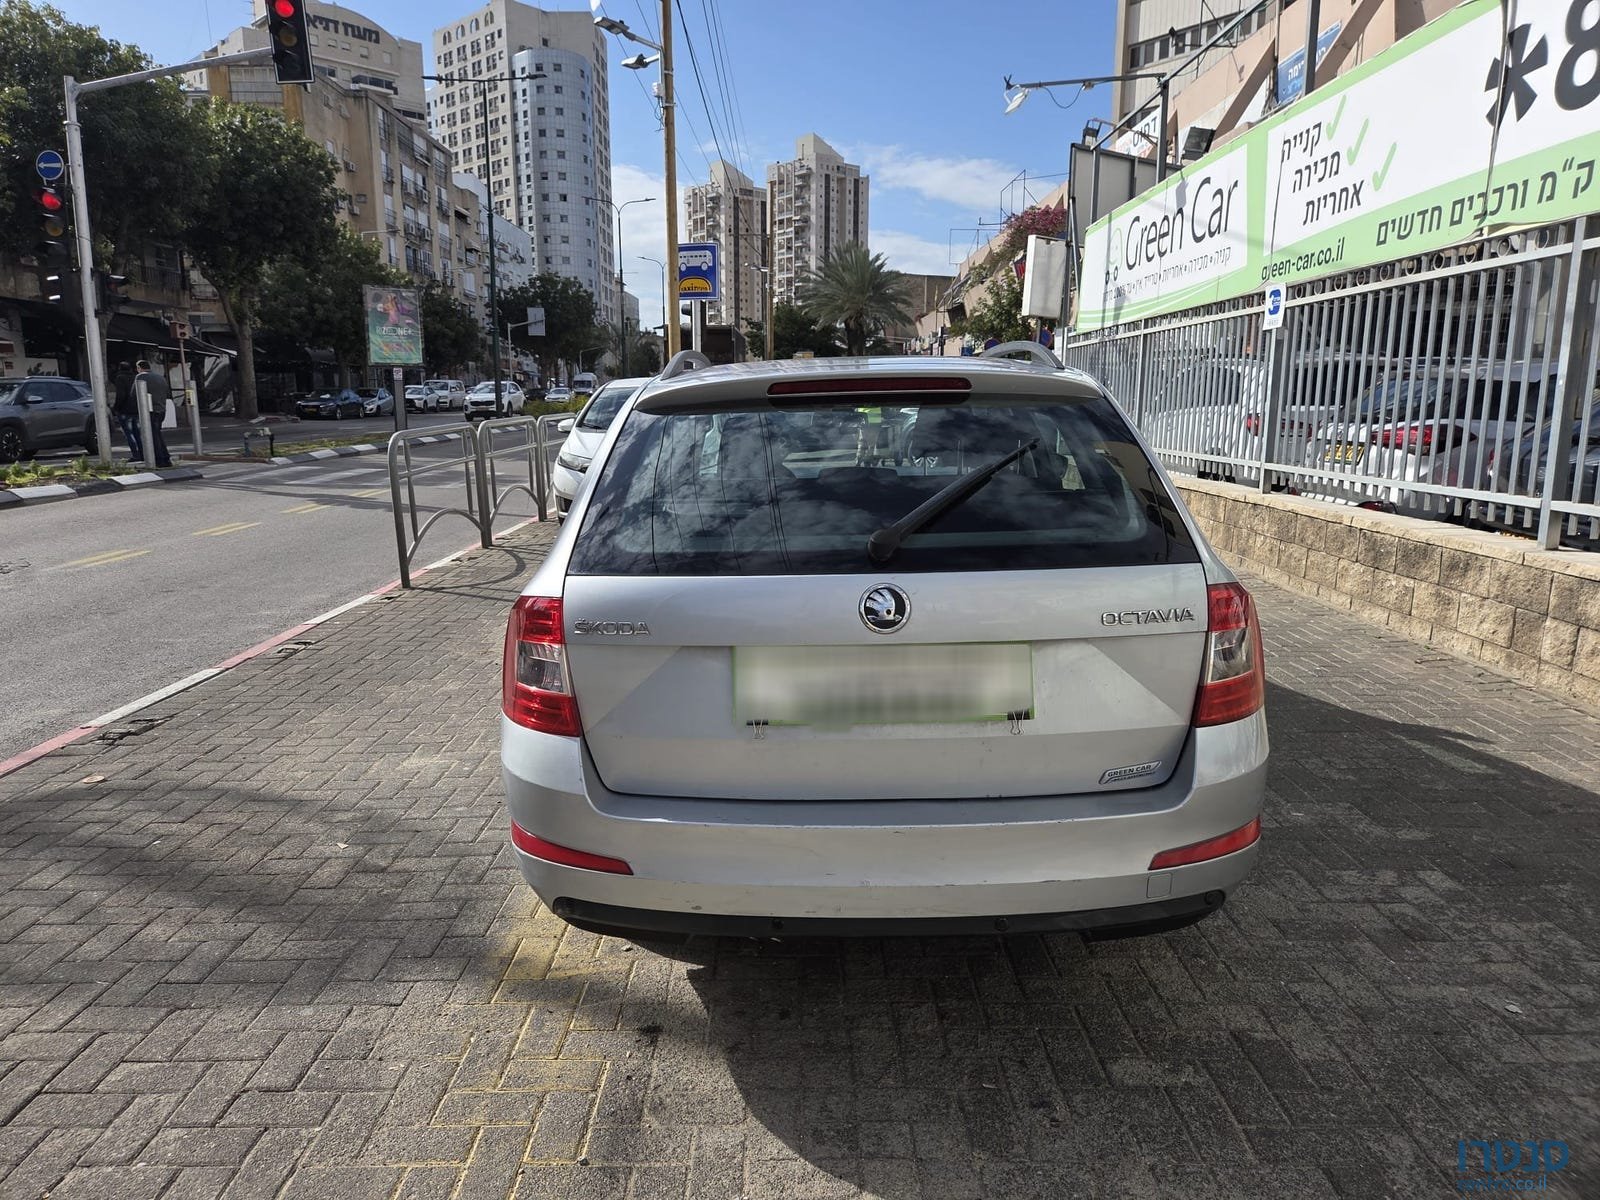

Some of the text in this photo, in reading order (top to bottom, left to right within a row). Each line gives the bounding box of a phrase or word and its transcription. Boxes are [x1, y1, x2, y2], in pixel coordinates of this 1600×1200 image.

[342, 22, 380, 44] מעוז
[1133, 116, 1157, 147] דפוס
[1293, 151, 1340, 193] מכירה
[1126, 176, 1239, 271] Green Car
[1303, 180, 1364, 226] אחריות
[1450, 178, 1529, 228] ורכבים
[1376, 205, 1442, 247] חדשים
[1261, 236, 1346, 281] green-car.co.il
[1101, 607, 1195, 626] OCTAVIA
[1107, 767, 1134, 778] GREEN
[1135, 764, 1152, 773] CAR
